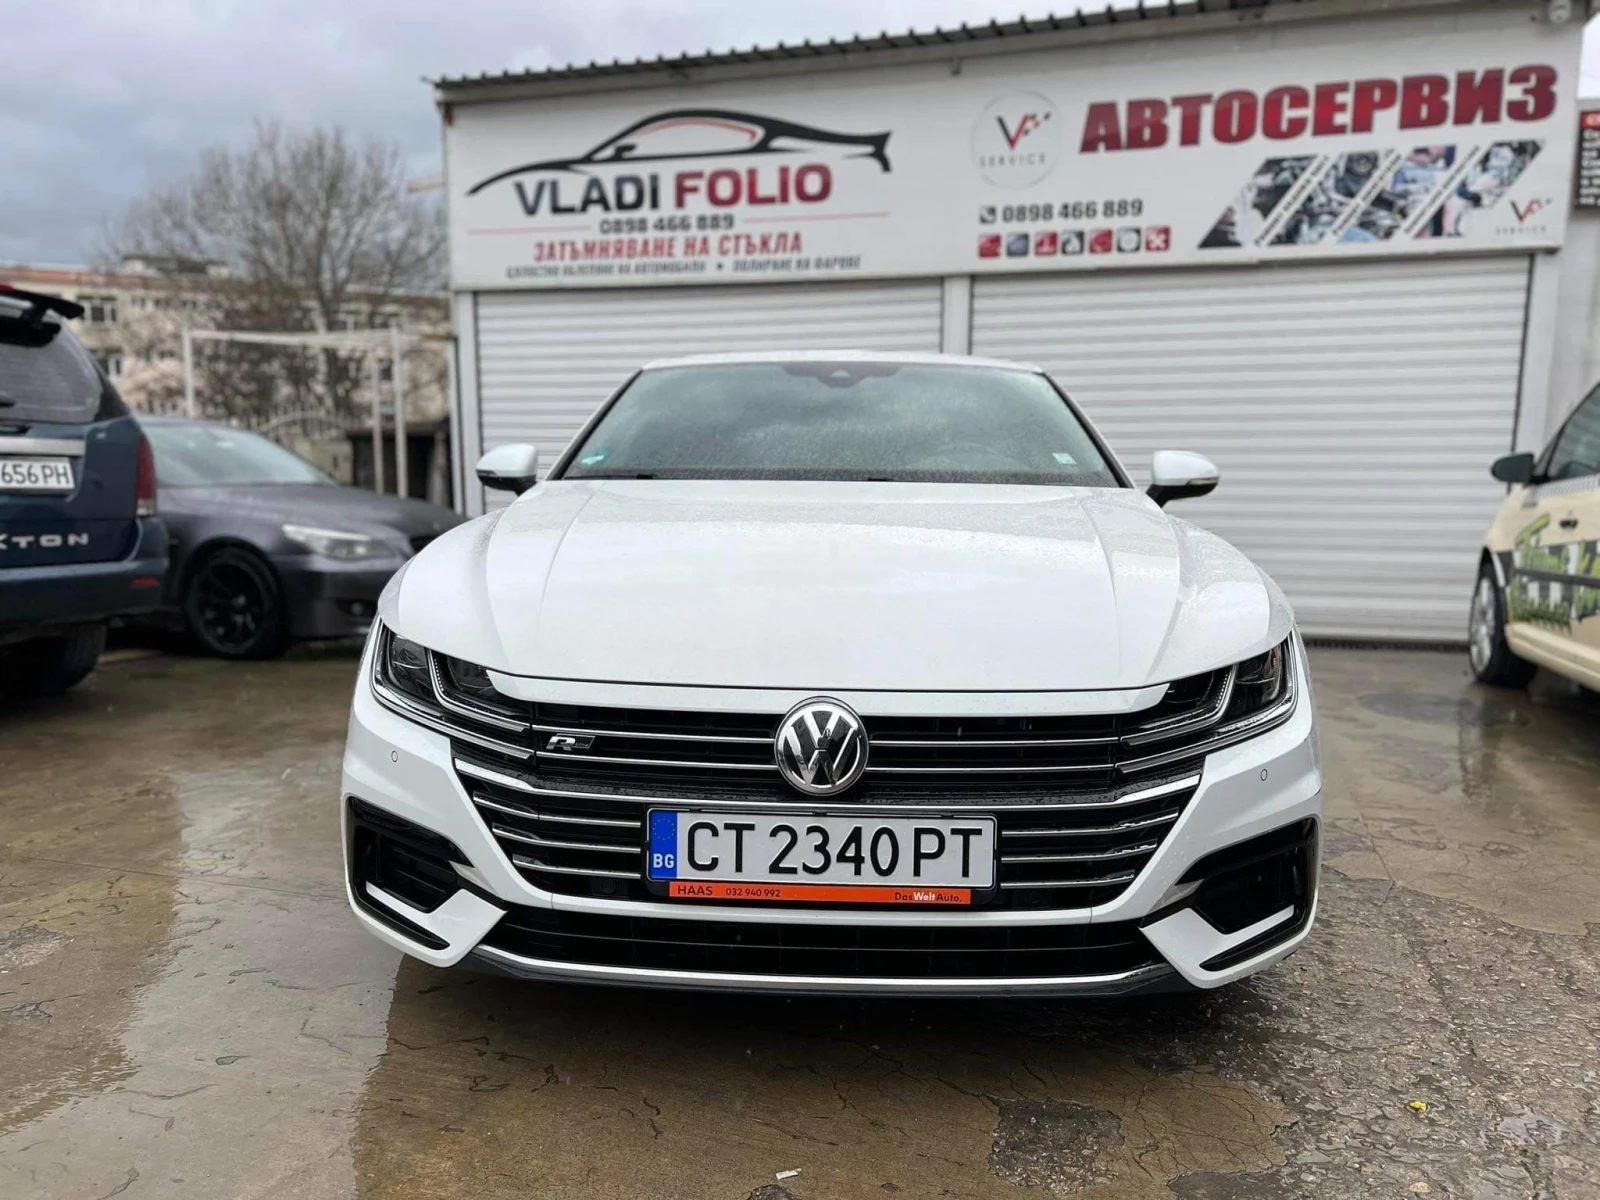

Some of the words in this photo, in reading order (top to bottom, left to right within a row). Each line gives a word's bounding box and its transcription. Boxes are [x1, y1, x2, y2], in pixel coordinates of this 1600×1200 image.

[1080, 64, 1557, 154] АВТОСЕРВИЗ
[514, 174, 659, 216] VLADI
[675, 164, 832, 209] FOLIO
[1003, 204, 1053, 223] 0898
[1059, 201, 1098, 219] 466
[1103, 199, 1143, 217] 889
[600, 218, 647, 235] 0898
[653, 216, 691, 232] 466
[697, 214, 734, 230] 889
[534, 237, 675, 262] ЗАТЪМНЯВАНЕ
[684, 235, 710, 257] НА
[719, 232, 802, 256] СТЪКЛА
[1, 464, 39, 485] 656
[42, 465, 70, 485] PH
[653, 852, 675, 869] BG
[687, 821, 756, 873] CT
[768, 824, 900, 877] 2340
[913, 826, 983, 878] PT
[677, 884, 714, 897] HAAS
[725, 888, 744, 898] 032
[745, 888, 762, 898] 940
[764, 889, 781, 899] 992
